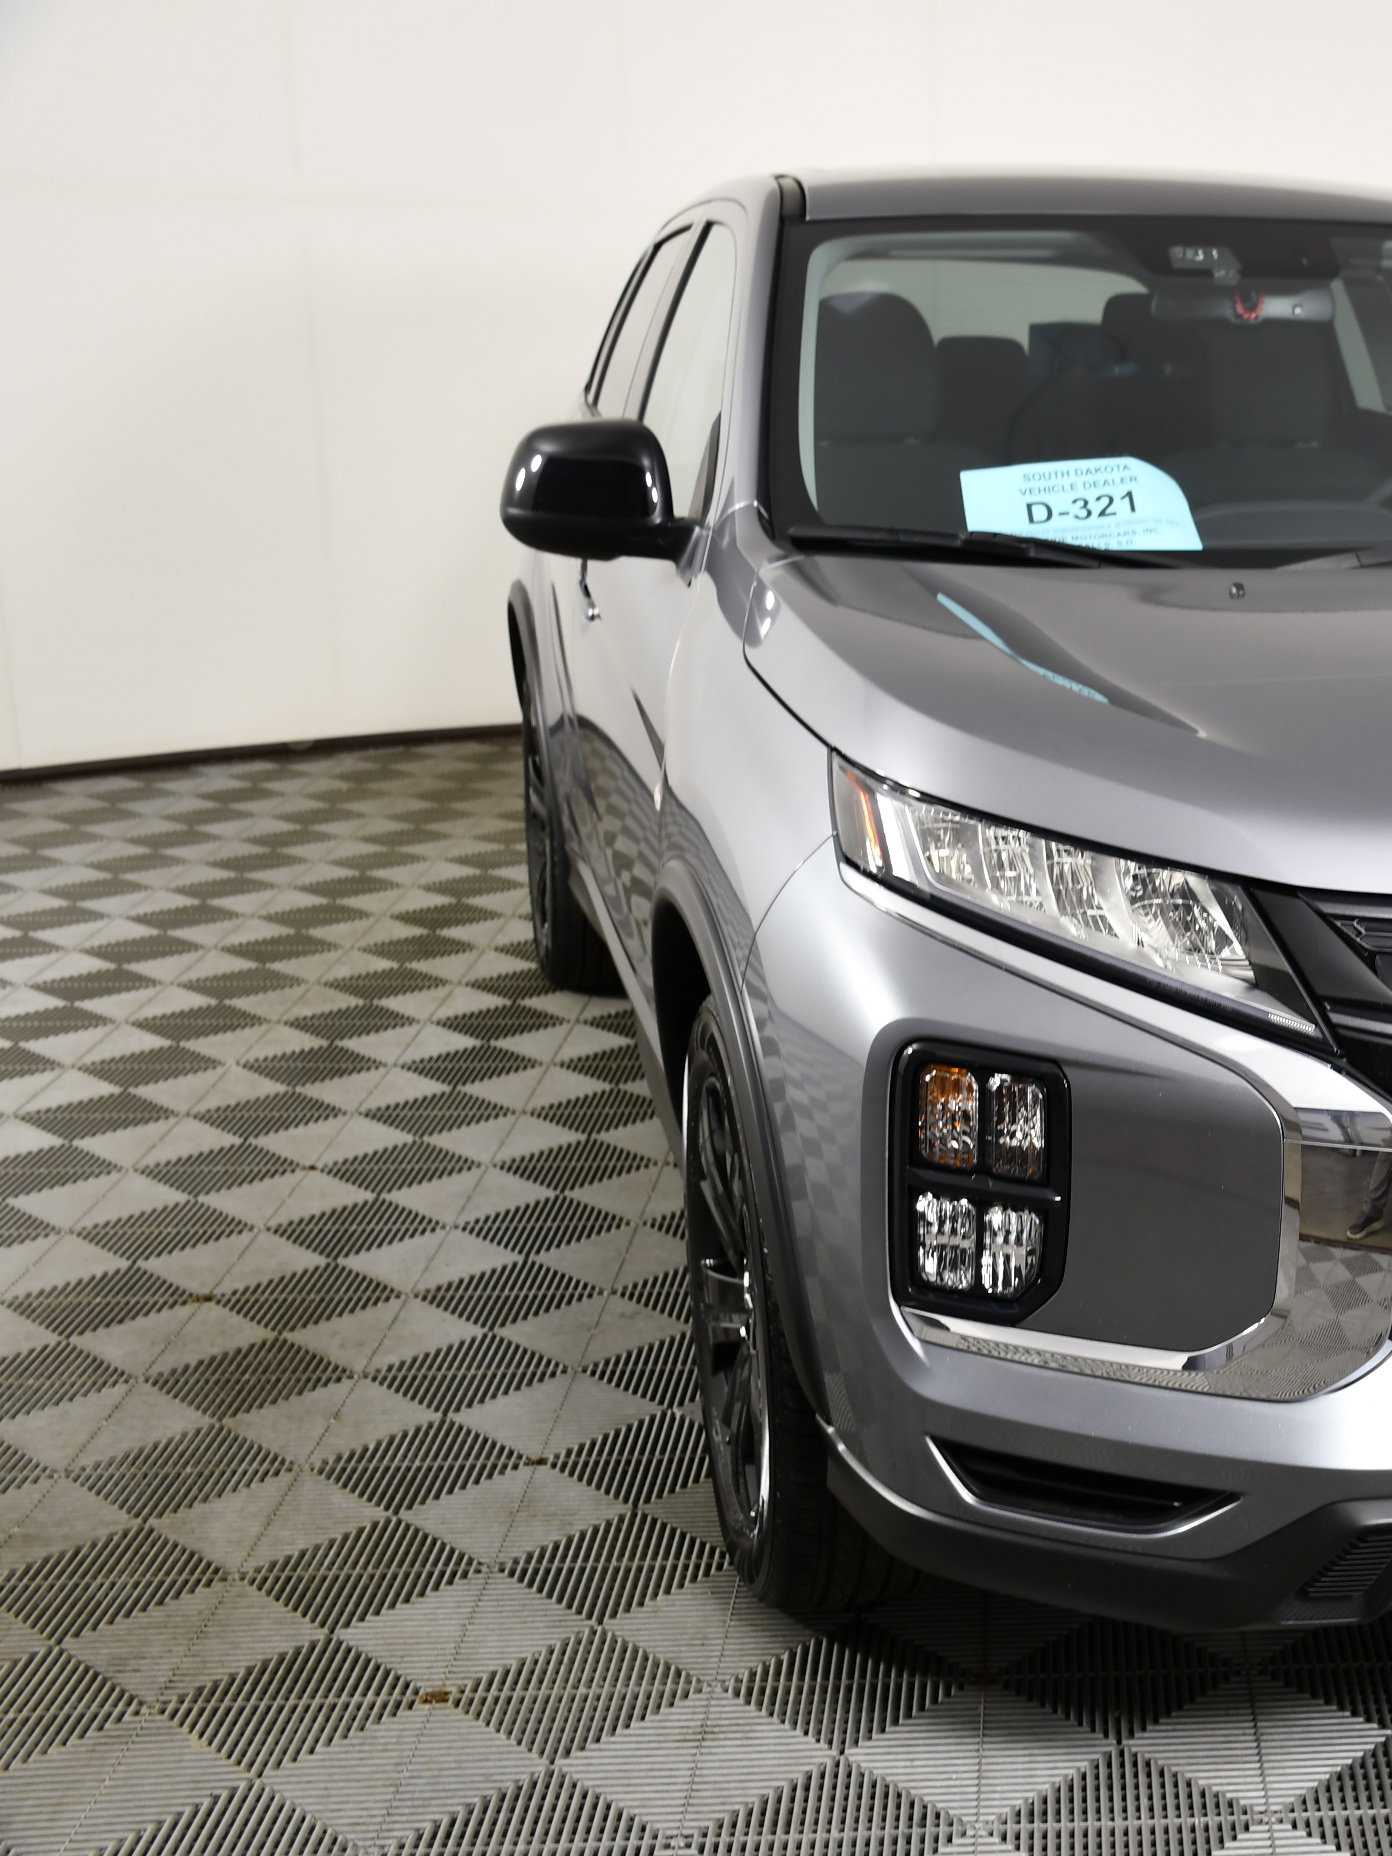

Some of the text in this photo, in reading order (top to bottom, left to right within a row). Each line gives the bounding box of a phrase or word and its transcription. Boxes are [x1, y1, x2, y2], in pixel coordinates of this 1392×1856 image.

[1022, 463, 1132, 483] SOUTH DAKOTA
[1018, 475, 1138, 497] VEHICLE DEALER
[1025, 490, 1137, 525] D-321
